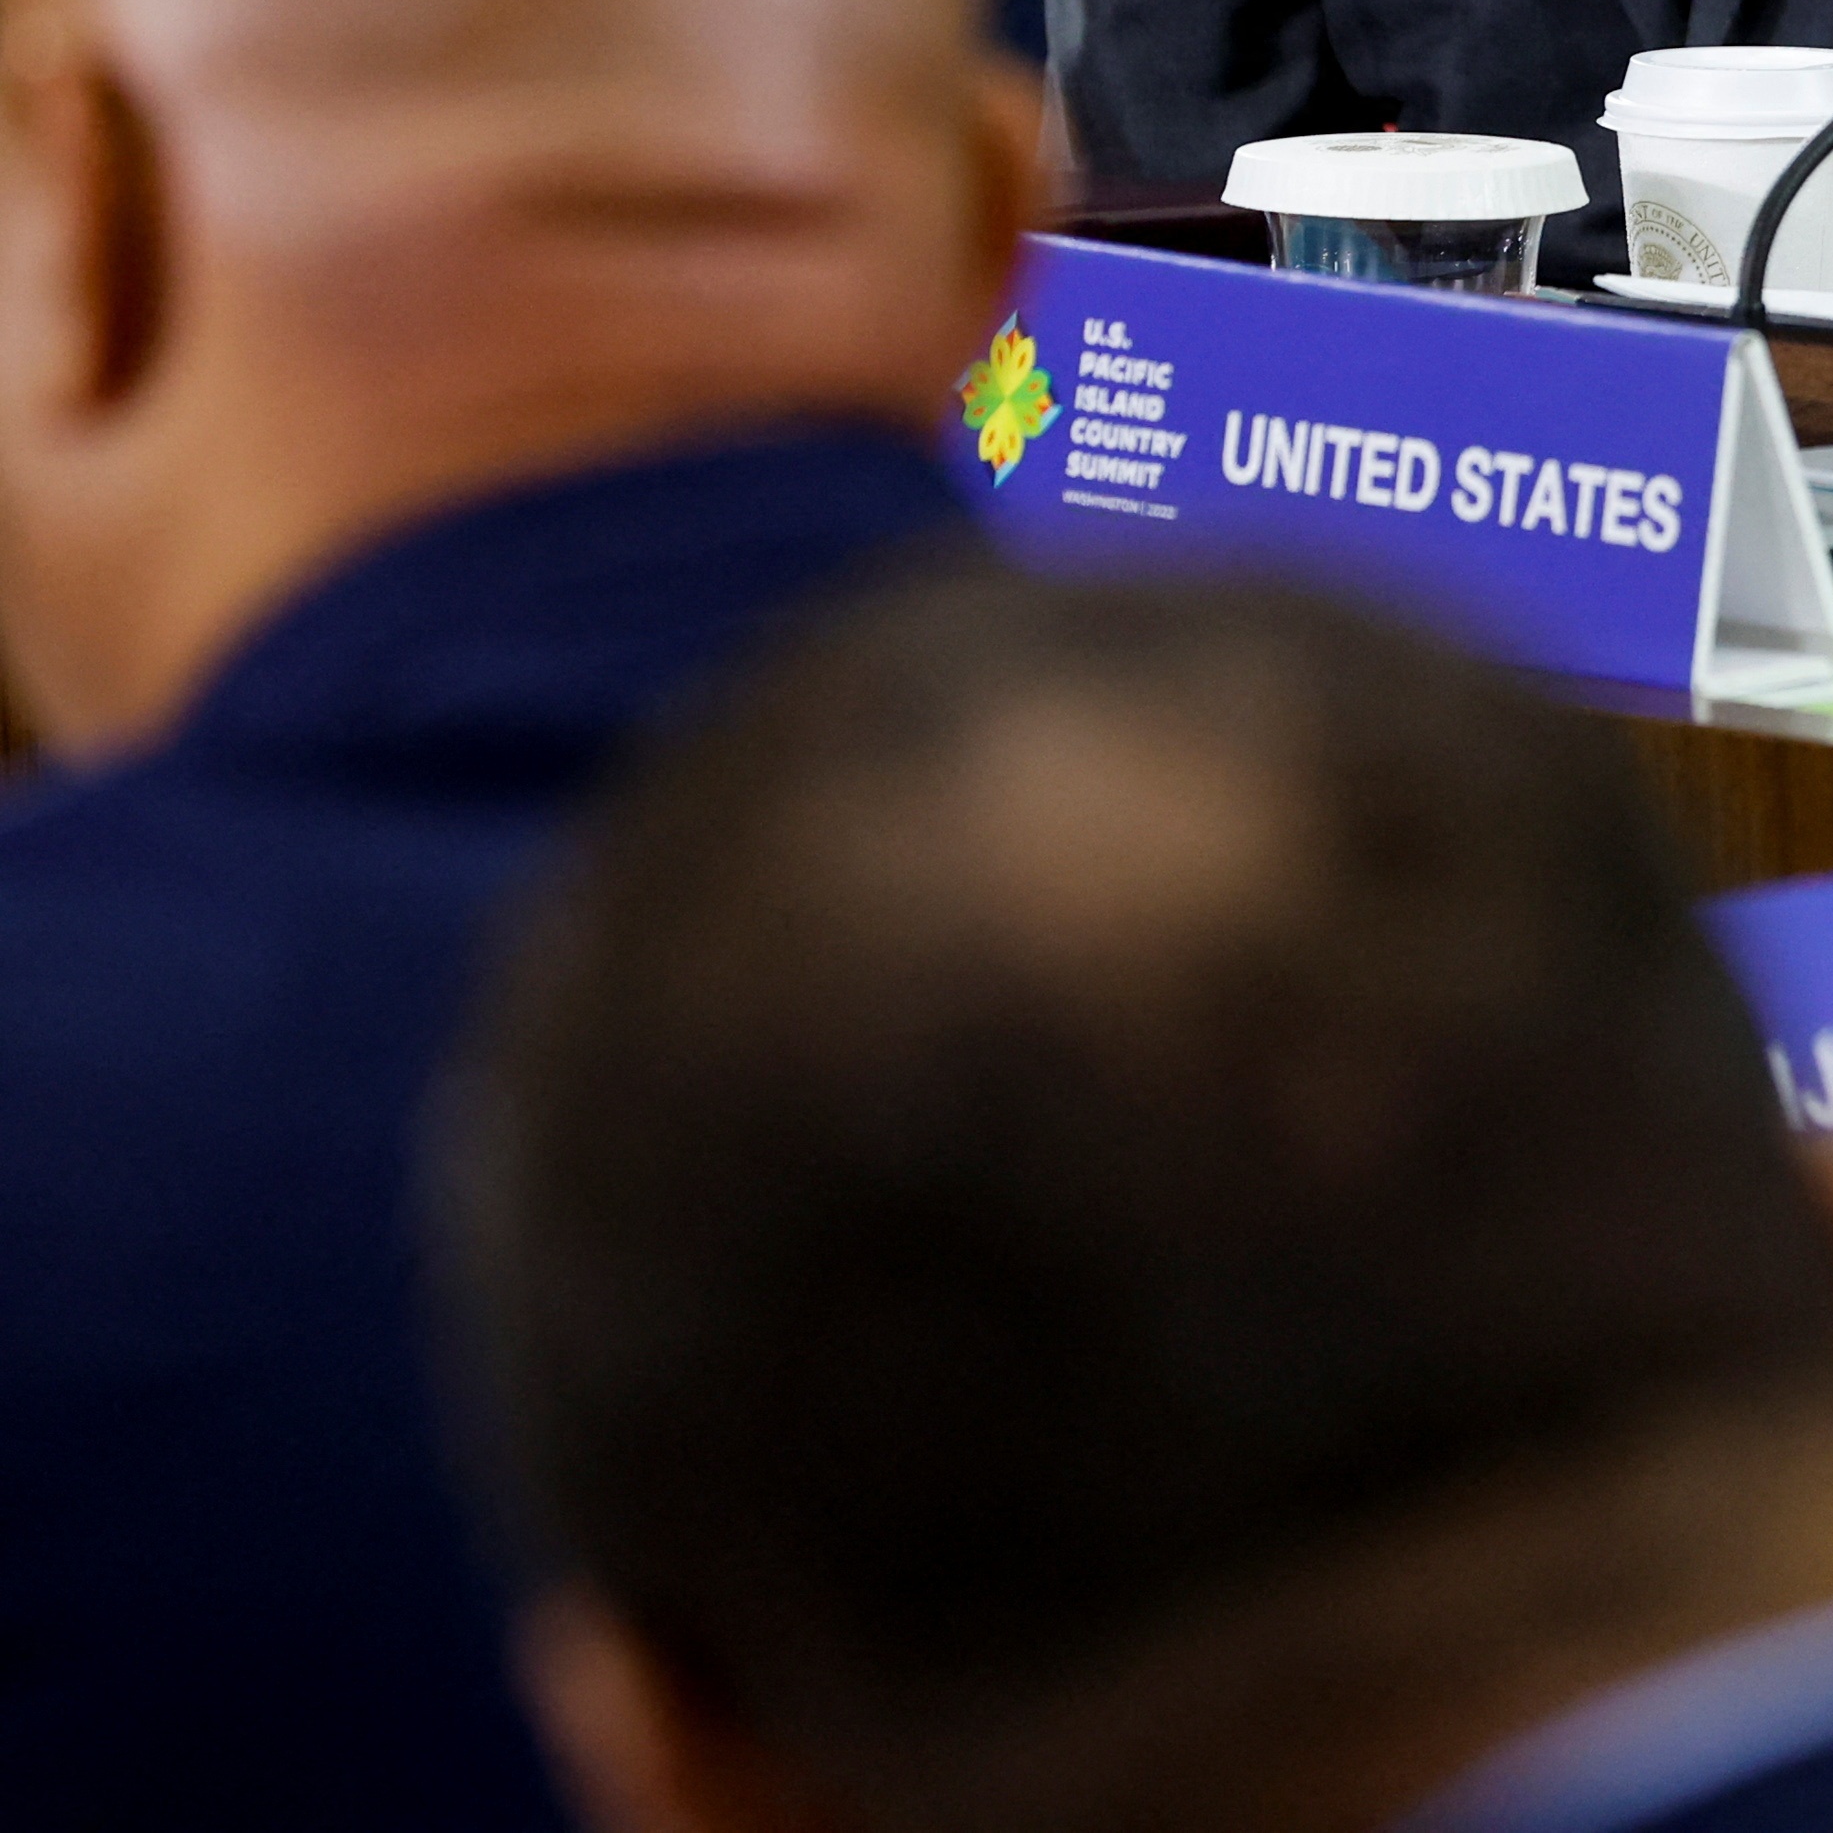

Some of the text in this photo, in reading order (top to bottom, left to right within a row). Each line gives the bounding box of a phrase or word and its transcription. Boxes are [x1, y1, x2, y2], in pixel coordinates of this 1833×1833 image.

[1689, 233, 1727, 285] UNIT
[1083, 317, 1133, 350] U.S.
[1078, 350, 1174, 391] PACIFIC
[1073, 383, 1166, 422] ISLAND
[1069, 416, 1188, 460] COUNTRY
[1064, 450, 1166, 490] SUMMIT
[1221, 409, 1683, 554] UNITED STATES
